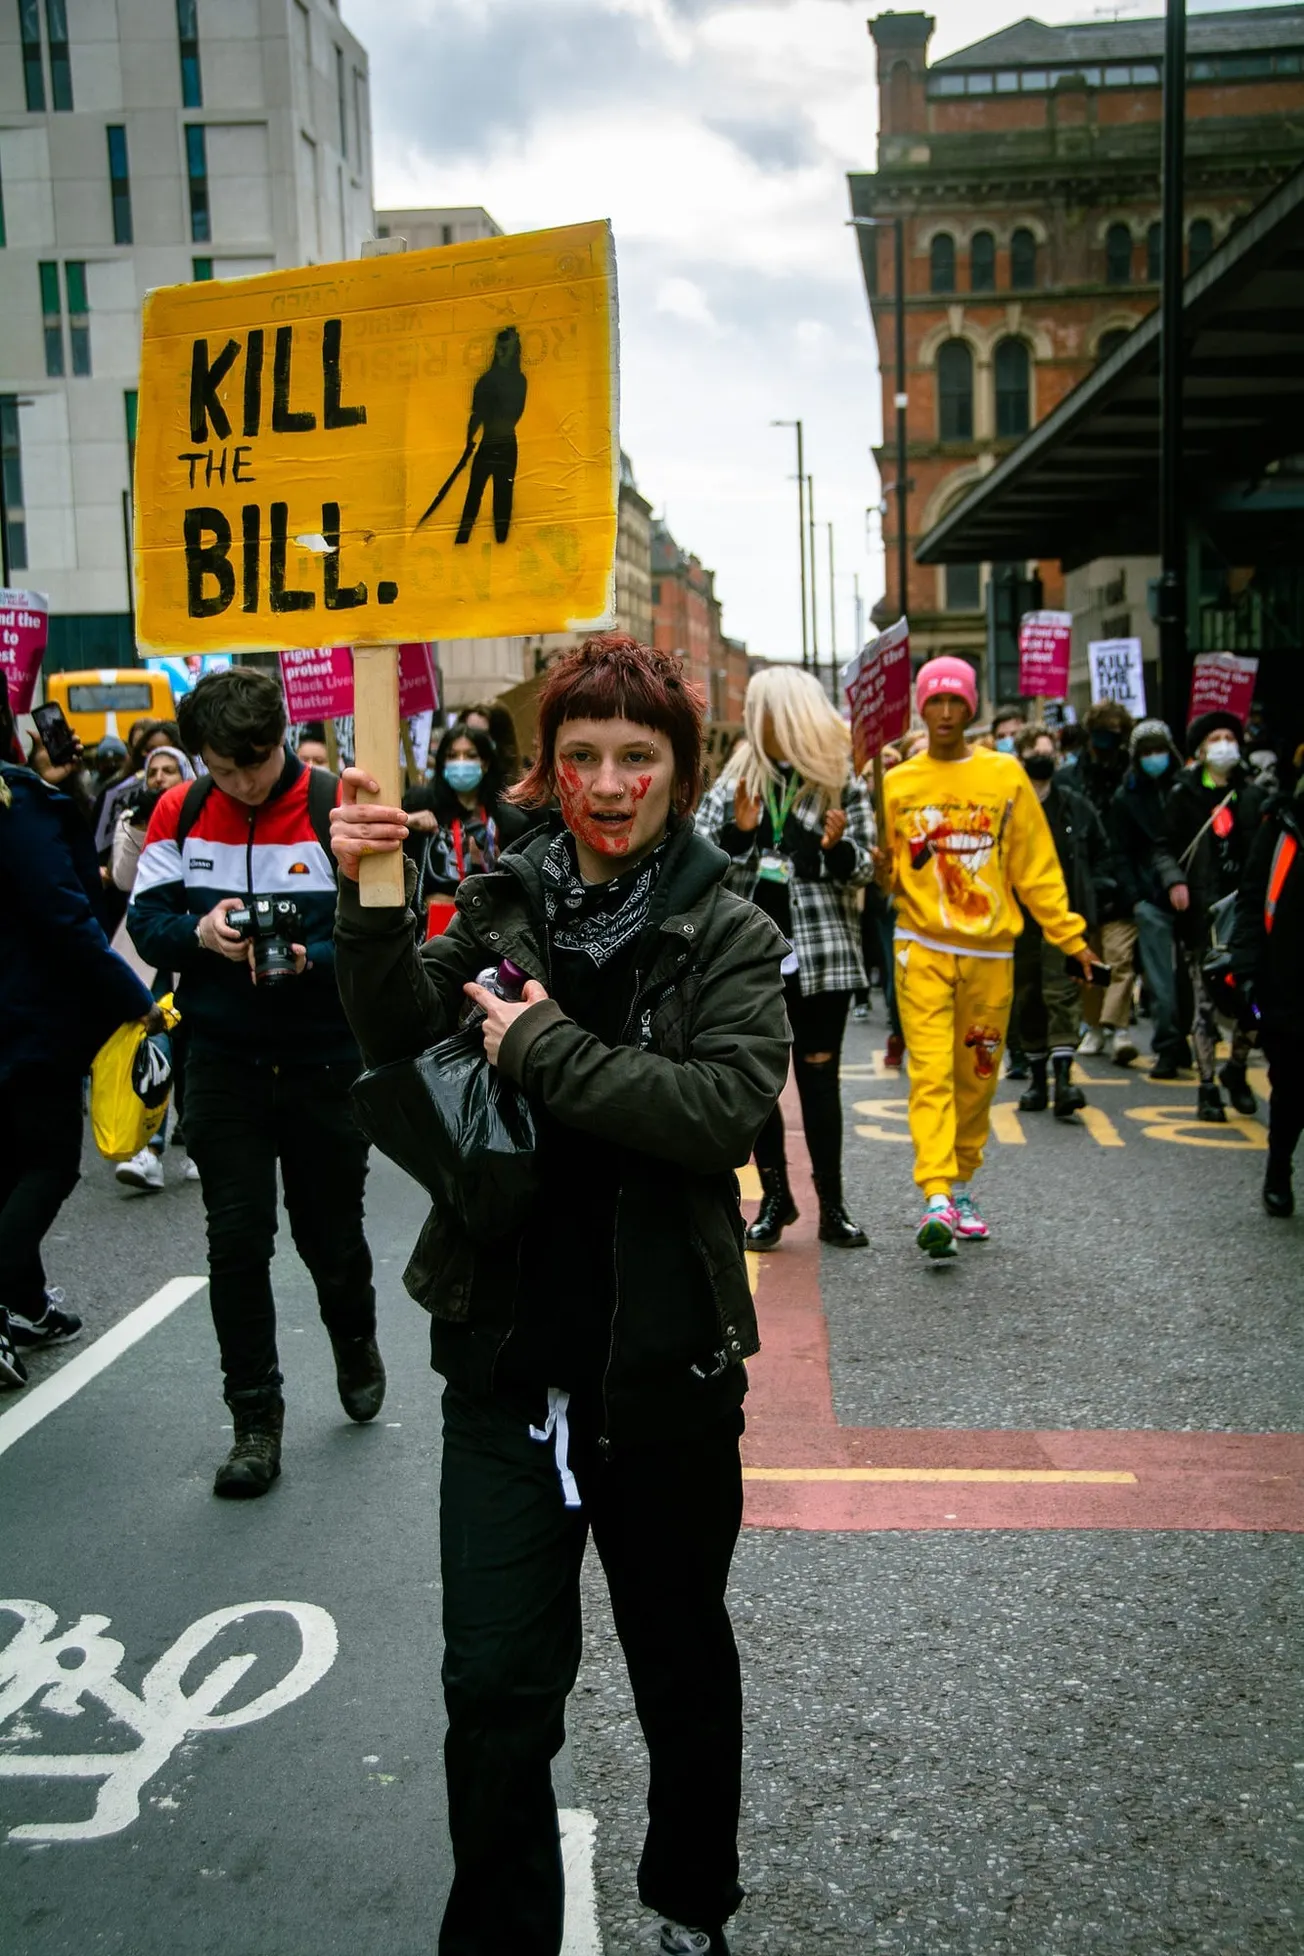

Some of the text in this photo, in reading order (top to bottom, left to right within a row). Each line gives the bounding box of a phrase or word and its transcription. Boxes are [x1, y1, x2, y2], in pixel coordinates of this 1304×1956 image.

[190, 319, 367, 444] KILL
[177, 446, 256, 490] THE
[184, 502, 398, 618] BILL.
[18, 611, 41, 629] the
[3, 629, 19, 646] to
[283, 647, 316, 665] right
[1096, 653, 1134, 669] KILL
[285, 660, 333, 681] protest
[1098, 669, 1128, 686] THE
[288, 678, 323, 695] Black
[290, 694, 334, 711] Matter
